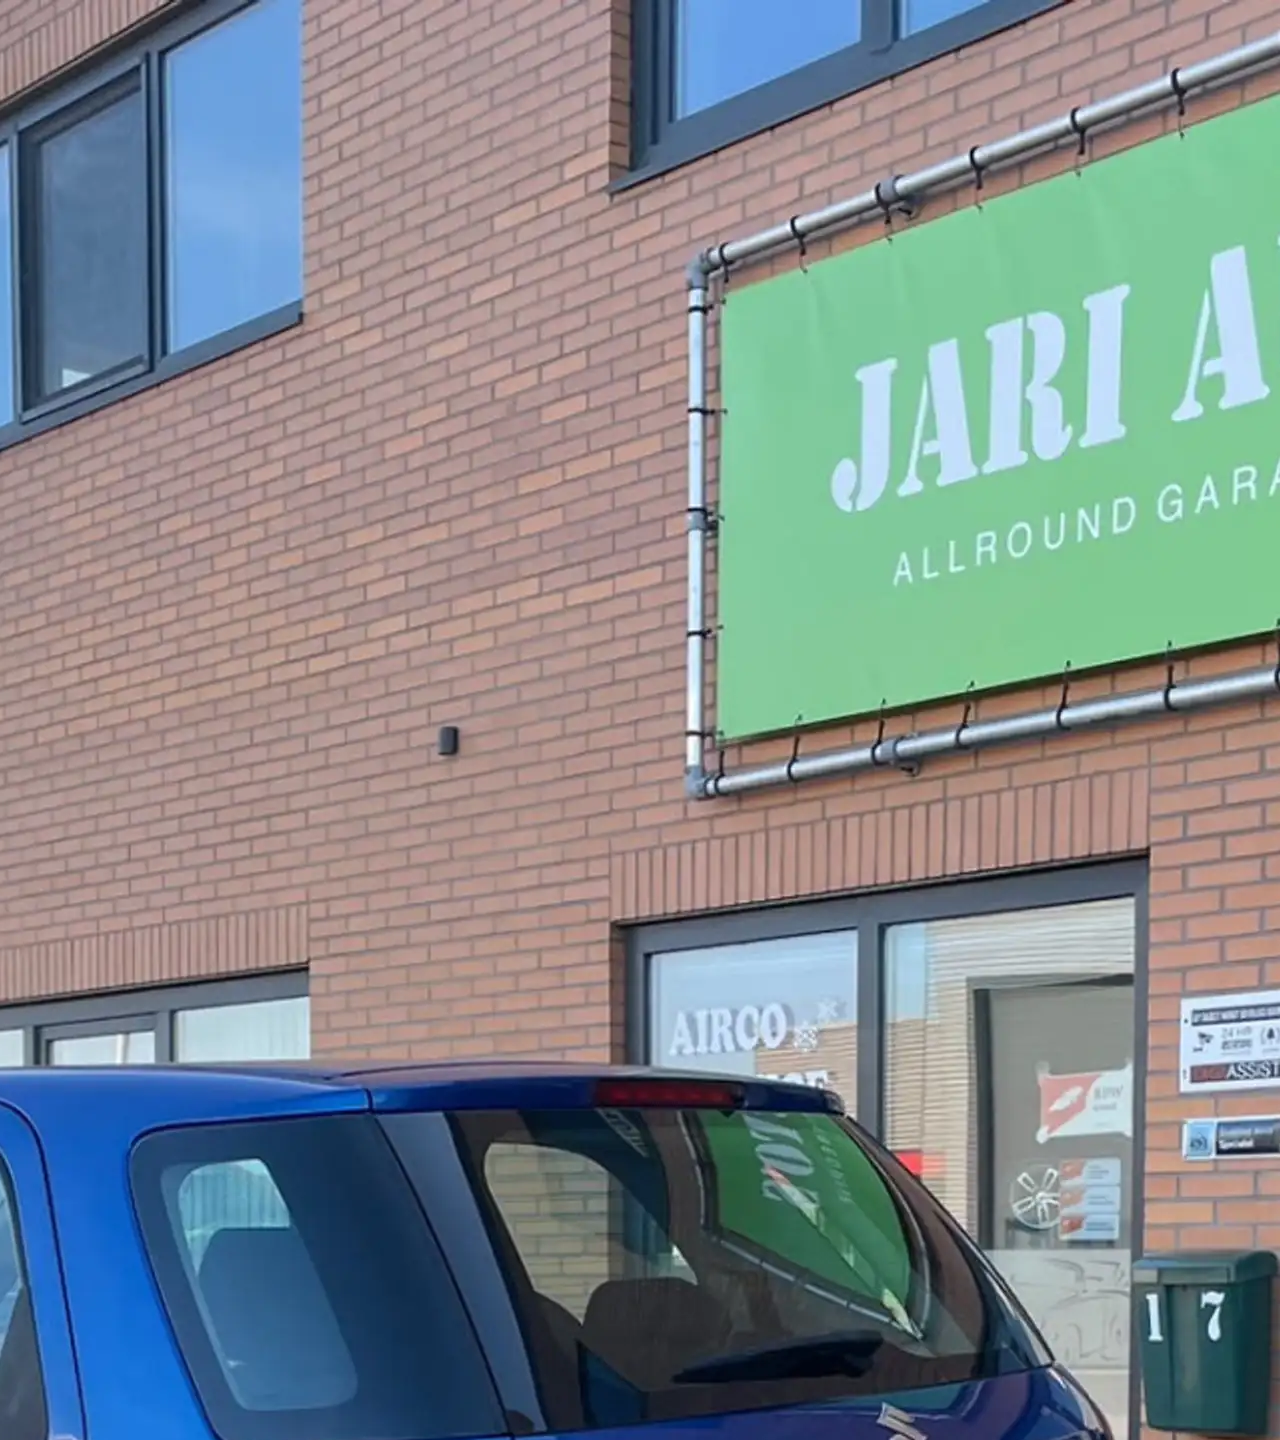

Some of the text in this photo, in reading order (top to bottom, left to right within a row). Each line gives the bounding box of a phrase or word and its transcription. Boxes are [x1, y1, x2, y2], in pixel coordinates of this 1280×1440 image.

[830, 283, 1131, 512] JARI
[893, 496, 1137, 587] ALLROUND
[669, 1002, 788, 1057] AIRCO
